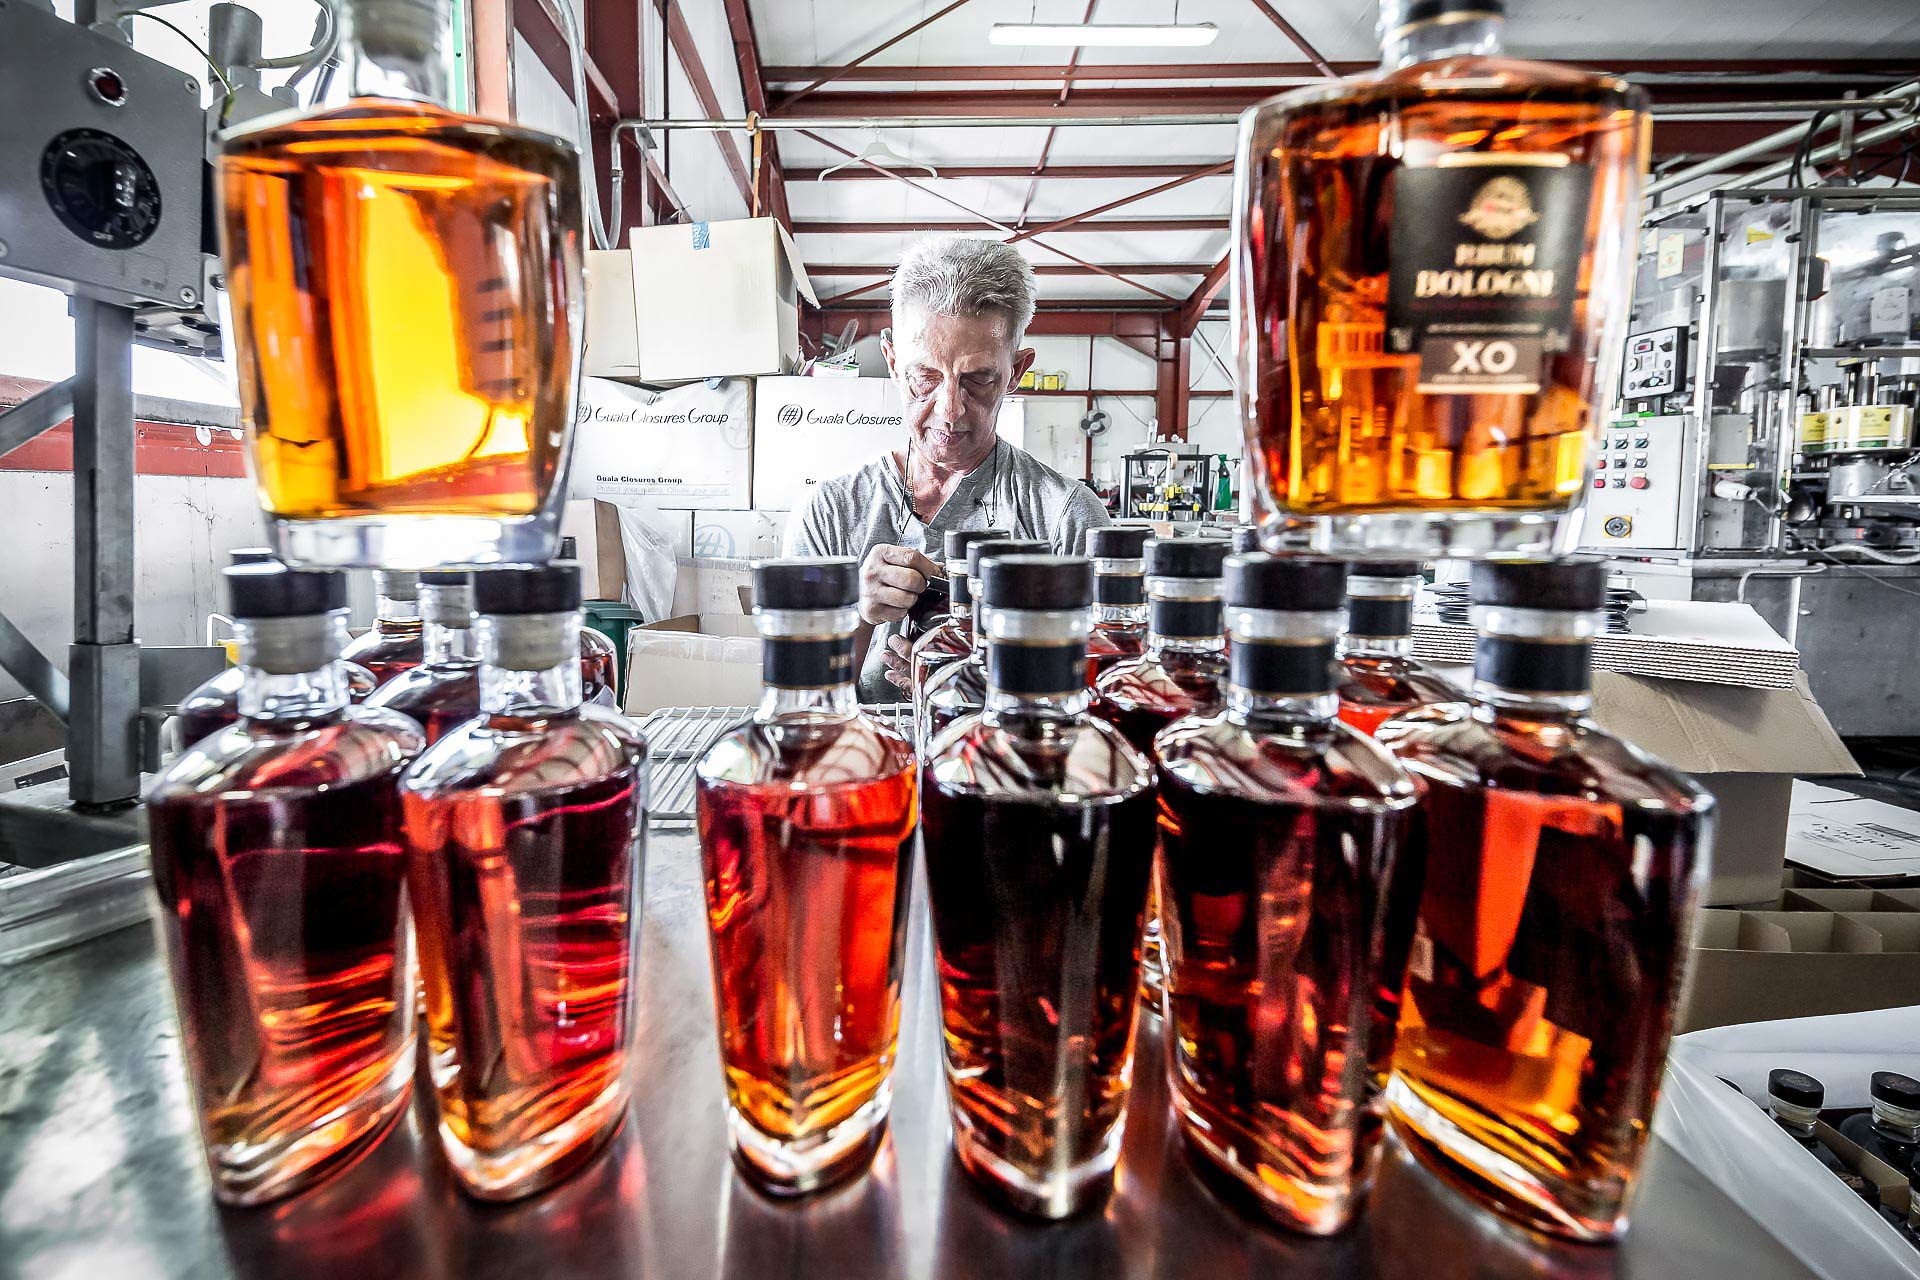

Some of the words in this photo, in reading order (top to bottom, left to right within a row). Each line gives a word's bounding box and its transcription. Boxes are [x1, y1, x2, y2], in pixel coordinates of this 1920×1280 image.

[1450, 340, 1517, 374] XO
[595, 406, 630, 423] Guala
[631, 408, 686, 424] Closures
[688, 407, 729, 425] Group
[806, 408, 845, 425] Guala
[846, 409, 903, 426] Closures
[596, 474, 619, 483] Guala
[620, 475, 656, 484] Closures
[657, 476, 683, 486] Group
